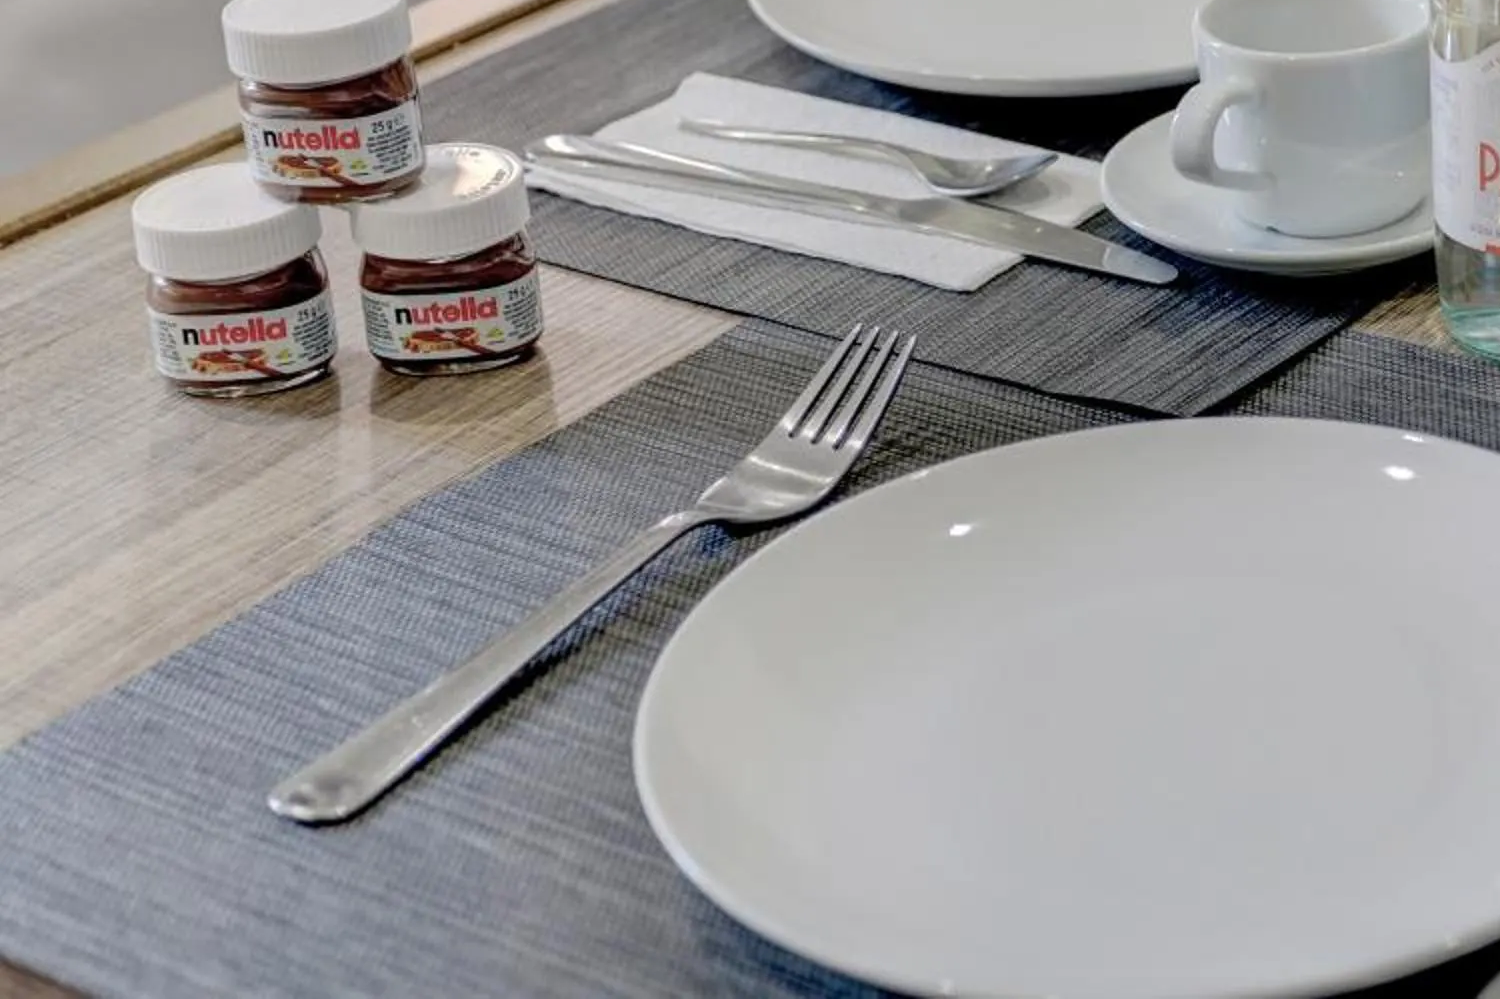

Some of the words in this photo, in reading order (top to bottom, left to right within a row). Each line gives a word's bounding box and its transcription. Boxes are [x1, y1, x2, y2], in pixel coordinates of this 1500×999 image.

[262, 123, 362, 151] nutella
[394, 296, 499, 325] nutella
[181, 316, 288, 346] nutella
